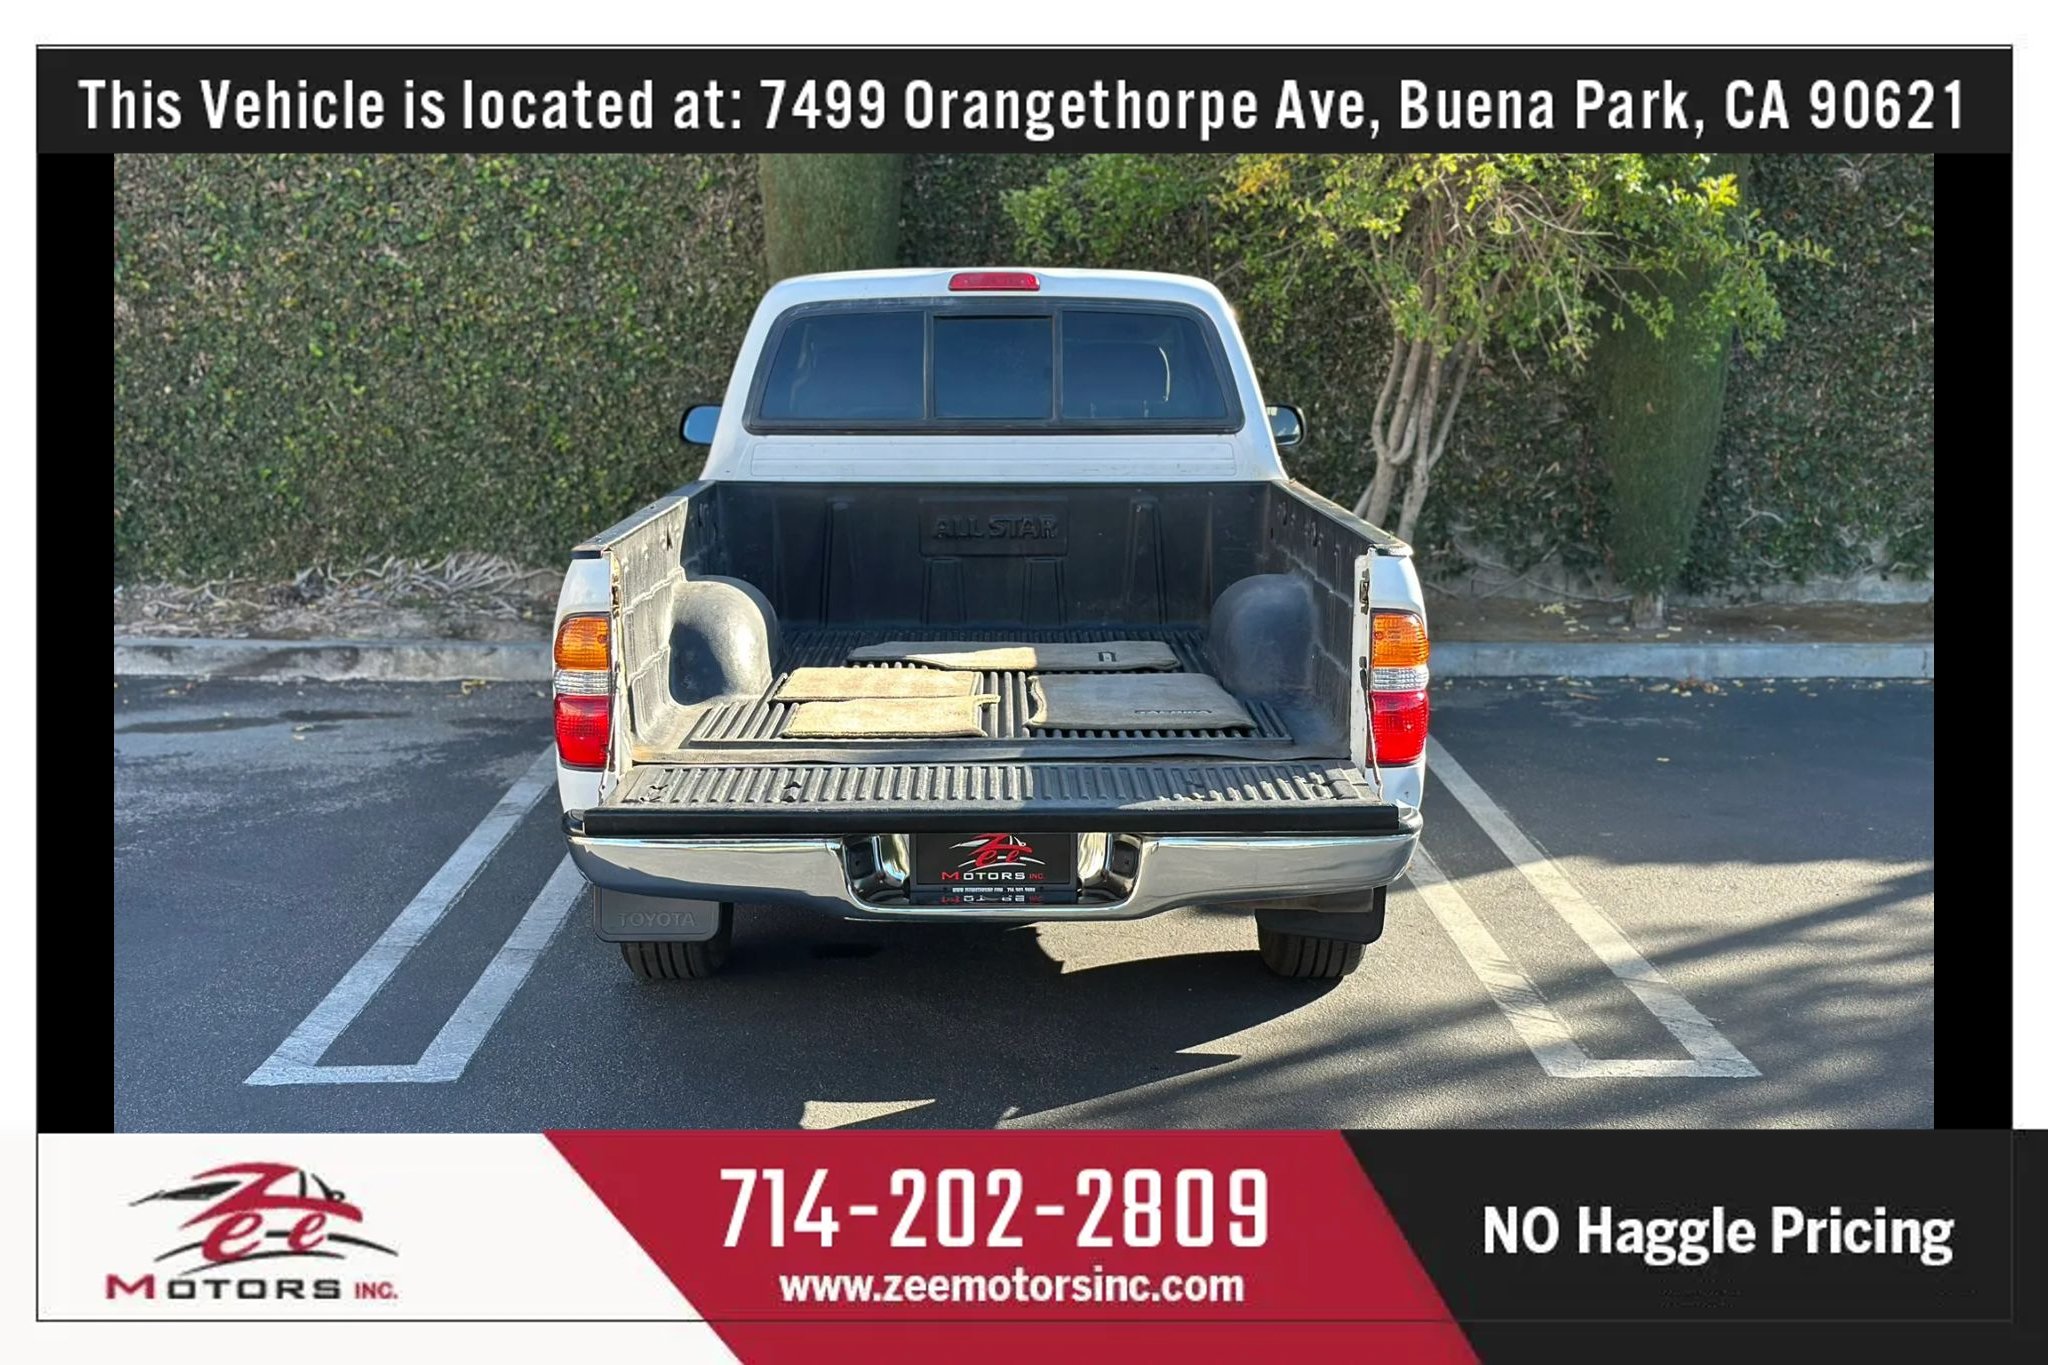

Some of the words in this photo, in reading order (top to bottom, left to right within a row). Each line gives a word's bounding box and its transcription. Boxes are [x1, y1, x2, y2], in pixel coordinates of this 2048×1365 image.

[934, 516, 983, 539] ALL
[988, 514, 1058, 539] STAR
[618, 912, 697, 927] TOYOTA
